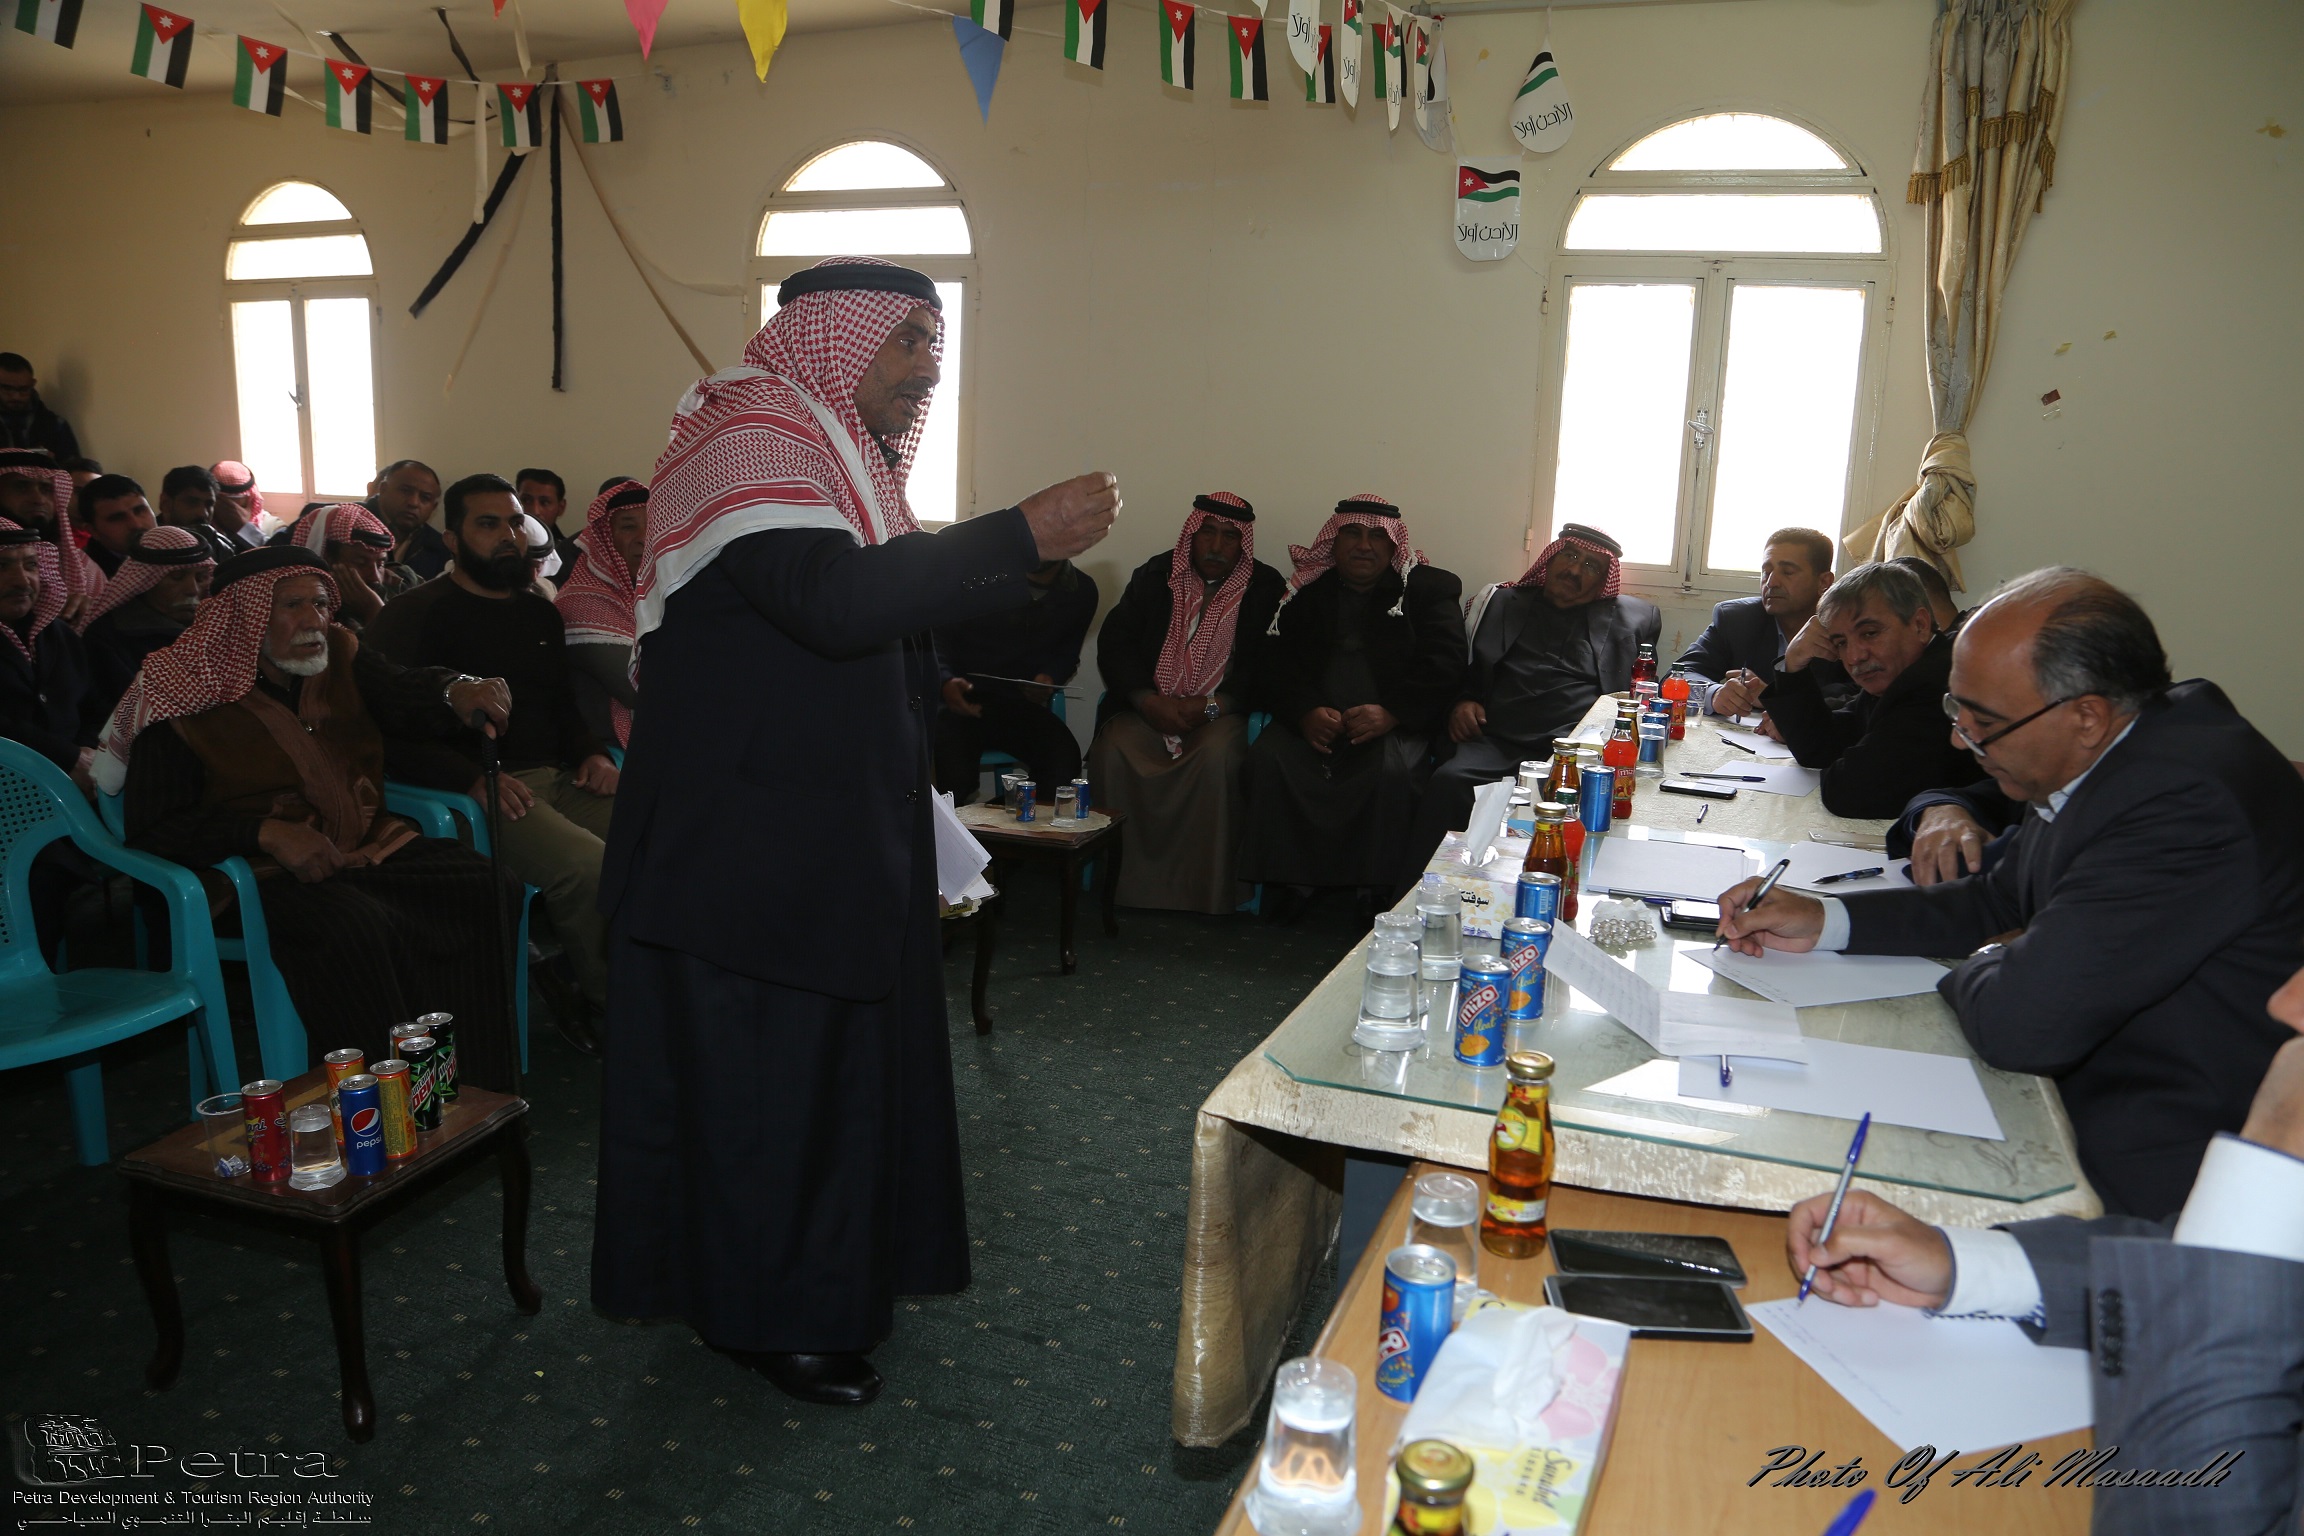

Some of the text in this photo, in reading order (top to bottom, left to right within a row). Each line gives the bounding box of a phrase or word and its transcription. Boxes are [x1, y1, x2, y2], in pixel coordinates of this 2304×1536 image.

[1534, 102, 1573, 131] الأردن
[1479, 221, 1519, 243] الأردن
[356, 1134, 382, 1150] pepsi
